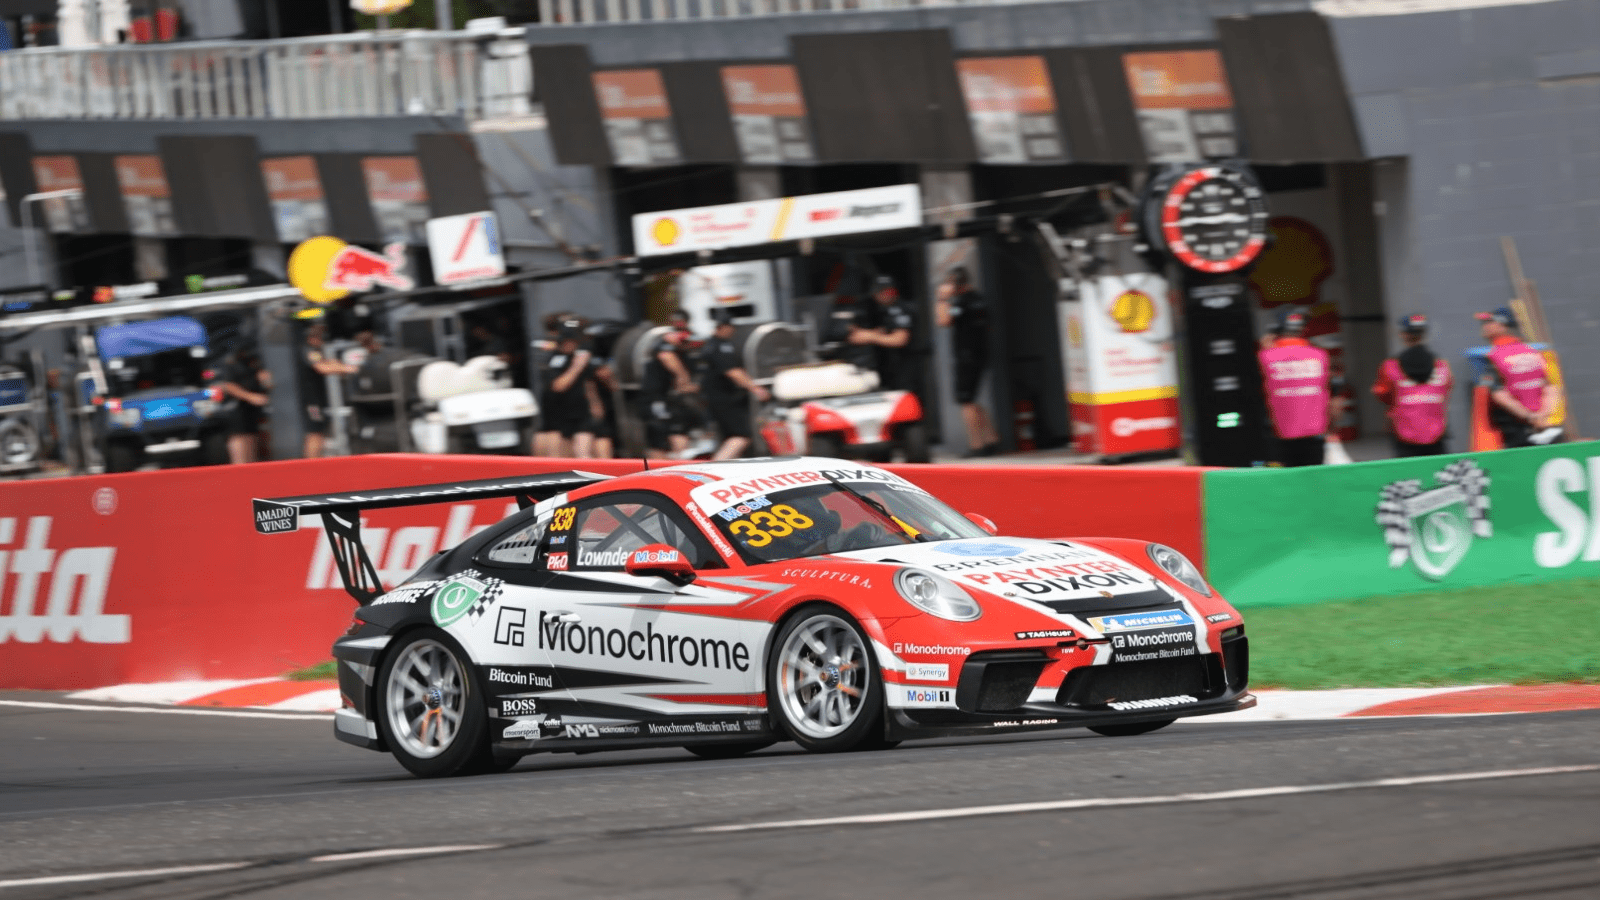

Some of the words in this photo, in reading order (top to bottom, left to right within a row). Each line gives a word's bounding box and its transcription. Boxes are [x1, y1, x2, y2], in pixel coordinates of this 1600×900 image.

[256, 507, 294, 522] AMADIO
[550, 507, 577, 531] 338
[261, 518, 292, 532] WINES
[729, 503, 814, 548] 338
[634, 550, 678, 563] Mobil
[962, 560, 1131, 586] PAYNTER
[1012, 571, 1144, 595] DIXON
[1124, 614, 1184, 627] MICHELIN
[538, 609, 750, 673] Monochrome
[1127, 631, 1194, 648] Monochrome
[904, 643, 971, 656] Monochrome
[1115, 650, 1158, 663] Monochrome
[1159, 648, 1180, 658] Bitcoin
[1180, 646, 1195, 656] Fund
[489, 668, 527, 685] Bitcoin
[529, 673, 553, 688] Fund
[918, 667, 947, 678] Synergy
[907, 690, 937, 702] Mobil
[940, 691, 949, 702] 1
[502, 699, 536, 711] BOSS
[648, 723, 696, 734] Monochrome
[695, 722, 722, 732] Bitcoin
[722, 721, 742, 732] Fund
